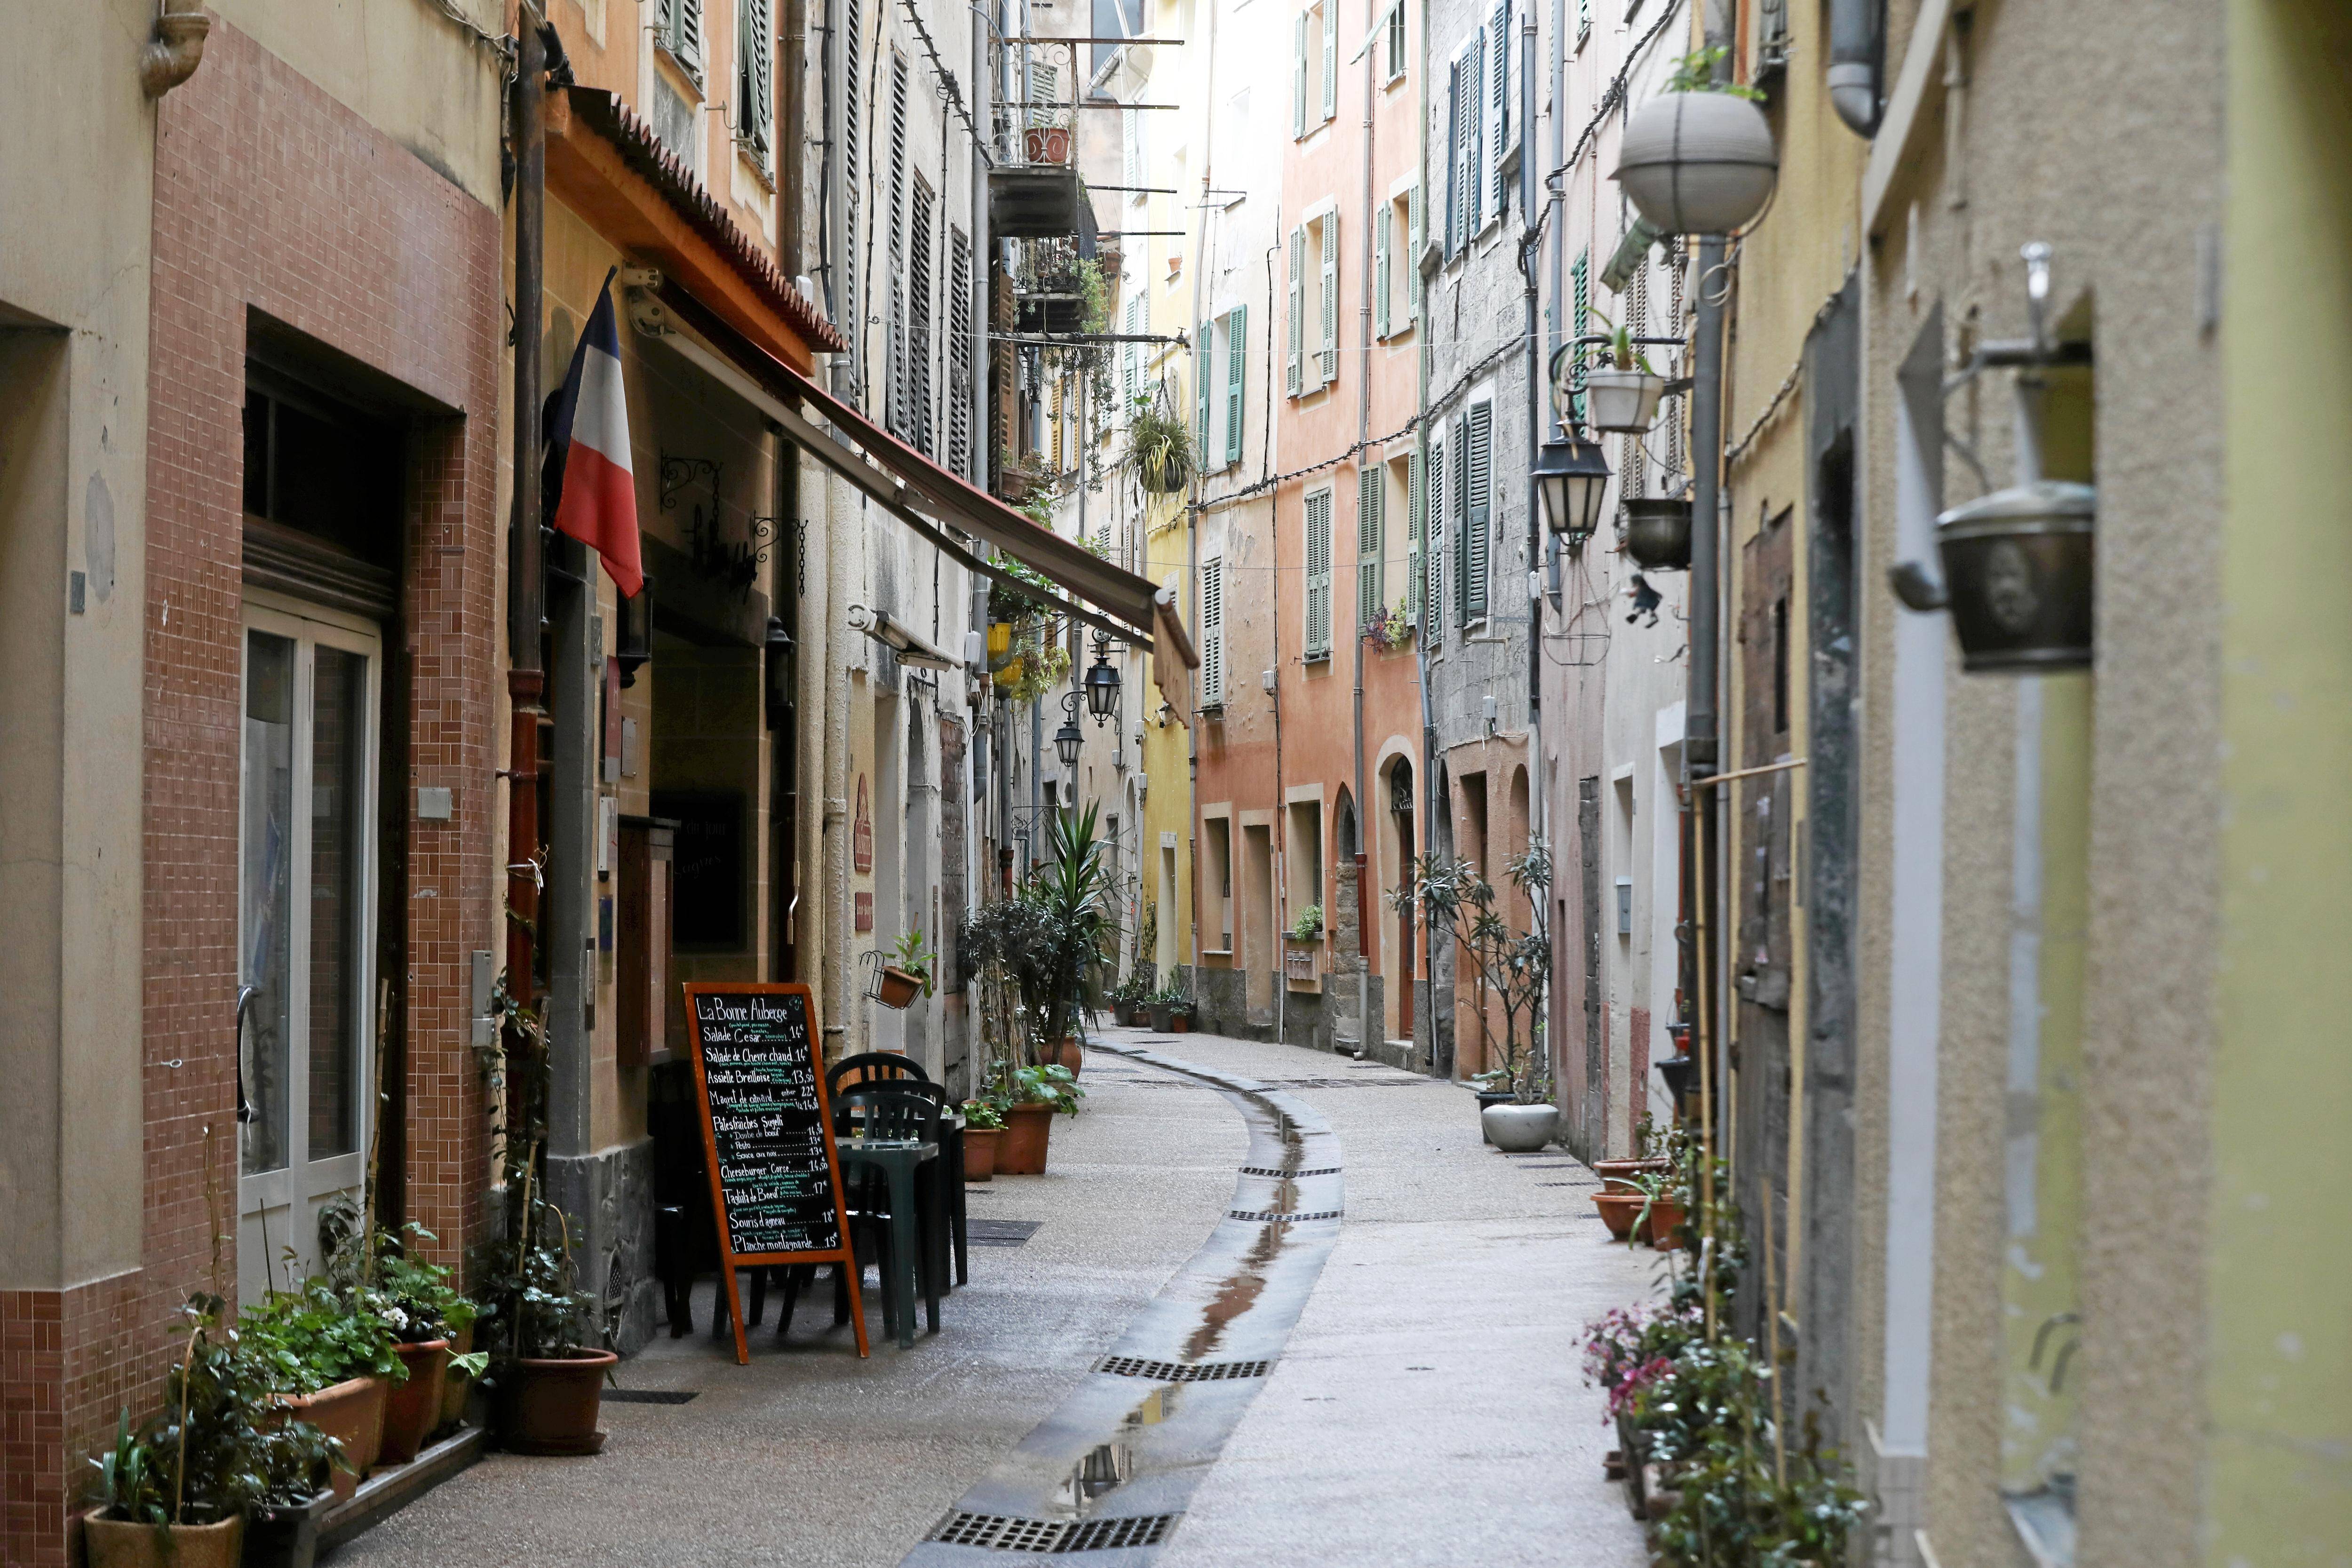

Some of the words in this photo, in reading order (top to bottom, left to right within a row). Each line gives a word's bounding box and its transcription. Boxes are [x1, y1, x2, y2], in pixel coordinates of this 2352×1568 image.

[696, 997, 715, 1020] La
[713, 997, 748, 1020] Bonne
[750, 998, 787, 1023] Auberge
[704, 1027, 731, 1042] Salade
[706, 1048, 731, 1062] Salade
[733, 1048, 740, 1061] de
[769, 1047, 793, 1062] chaud
[708, 1070, 734, 1084] Assiette
[736, 1069, 770, 1084] Breilloise
[739, 1089, 747, 1105] de
[749, 1088, 772, 1104] canard
[761, 1114, 784, 1130] Sugelli
[733, 1131, 754, 1140] Daube
[735, 1141, 751, 1150] Pesto
[721, 1162, 767, 1179] Cheeseburger
[722, 1188, 749, 1205] Tagliata
[750, 1188, 757, 1203] de
[730, 1213, 759, 1229] Souris
[732, 1234, 766, 1252] Planche
[767, 1232, 812, 1251] montagnarde
